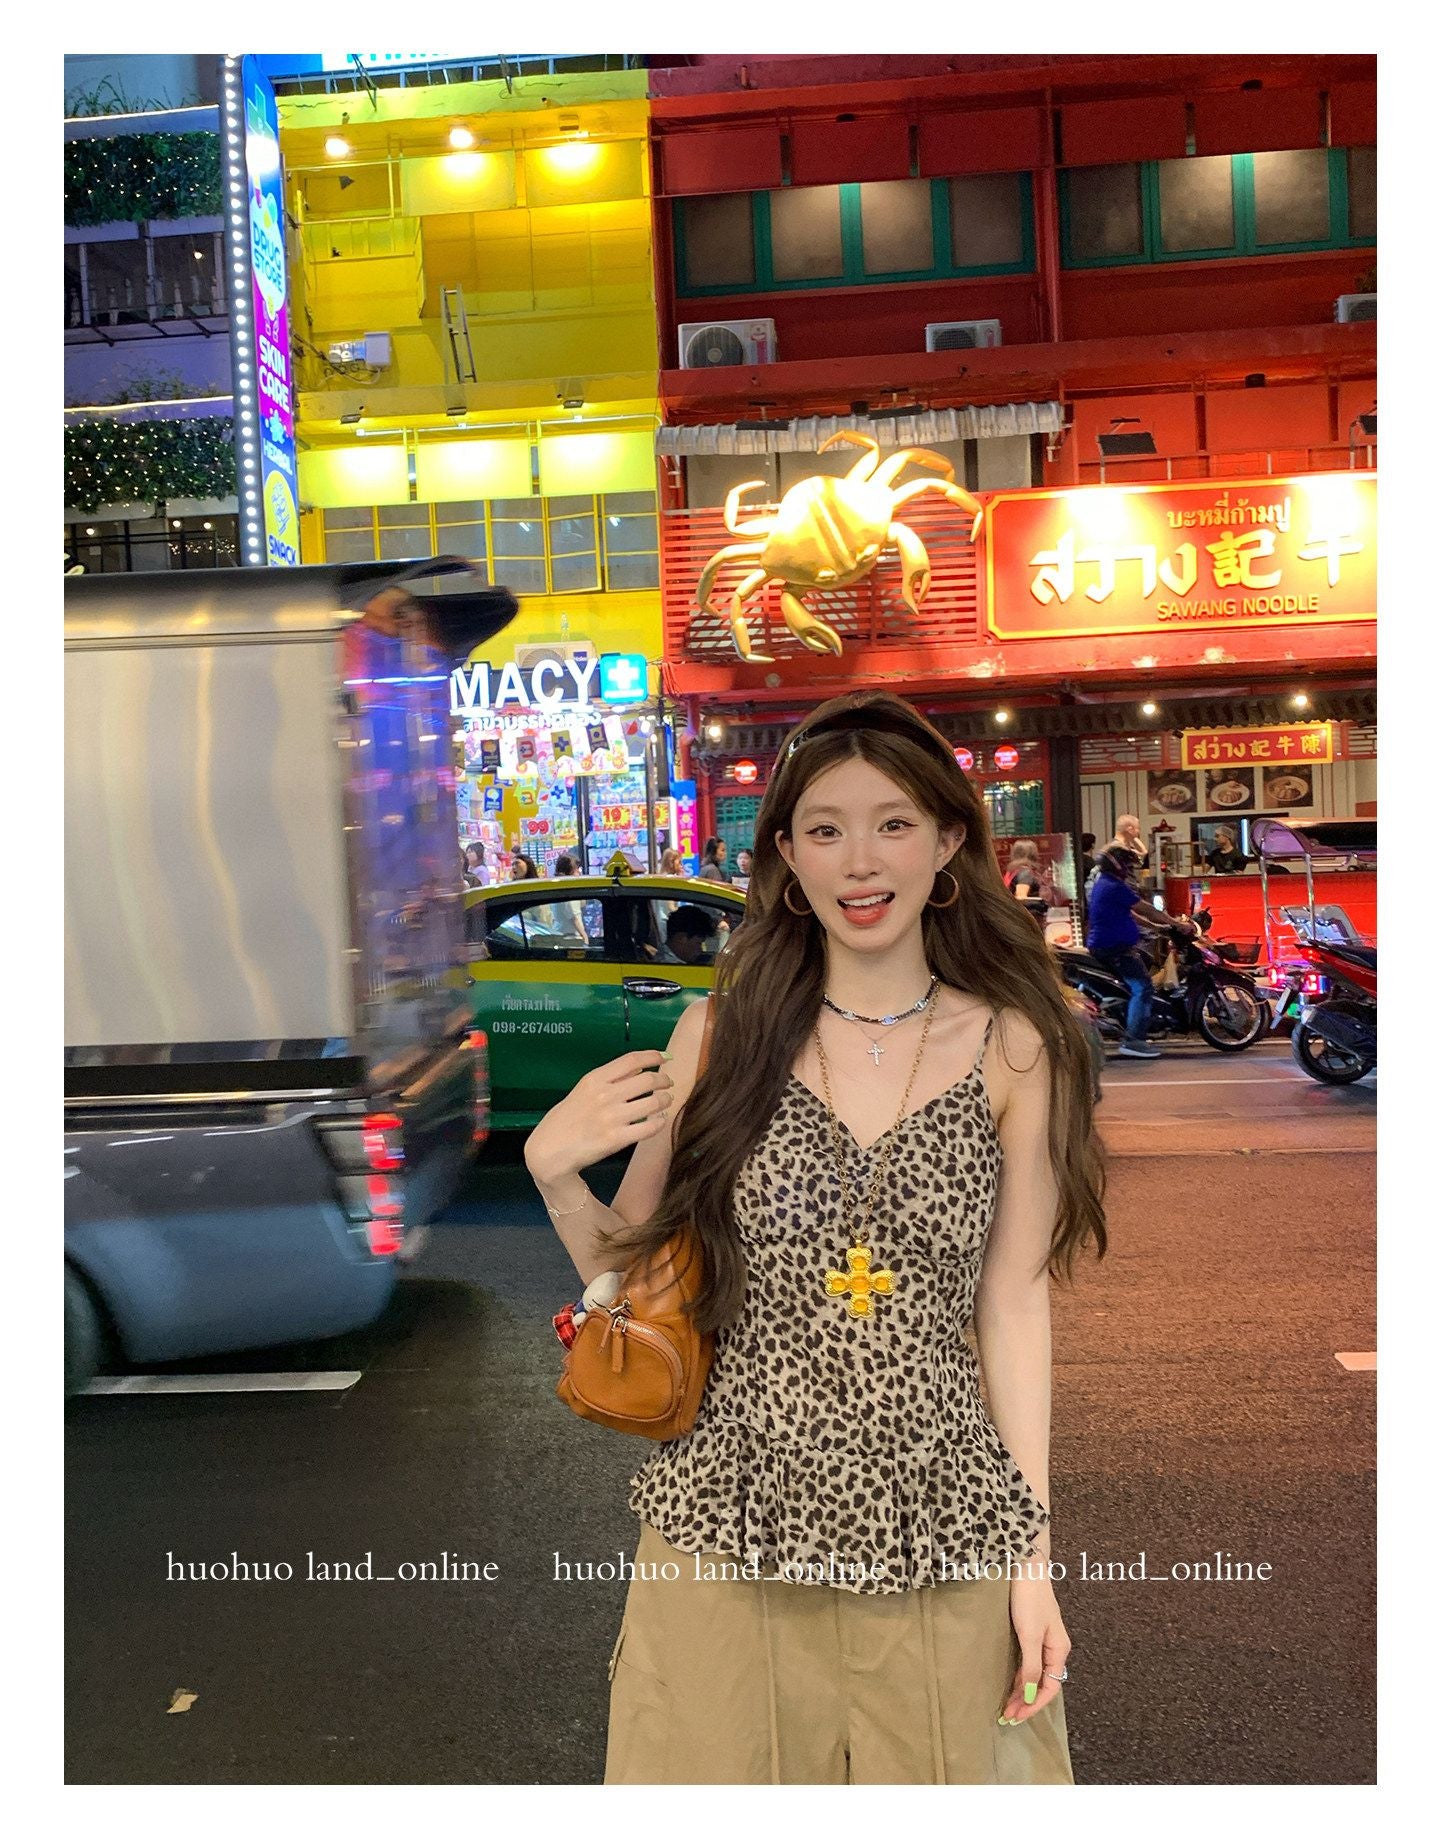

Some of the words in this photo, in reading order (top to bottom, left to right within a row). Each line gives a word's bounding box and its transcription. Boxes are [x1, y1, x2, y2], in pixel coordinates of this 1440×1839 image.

[253, 221, 281, 270] DRUG
[254, 248, 283, 293] STORE
[259, 335, 286, 381] SKIN
[259, 365, 289, 414] CARE
[1167, 491, 1291, 533] บะหมี่ก้ามปู
[269, 534, 296, 566] SNACK
[1157, 597, 1237, 620] SAWANG
[1243, 592, 1321, 615] NOODLE
[527, 820, 549, 835] 99
[492, 1021, 573, 1034] 098-2674065
